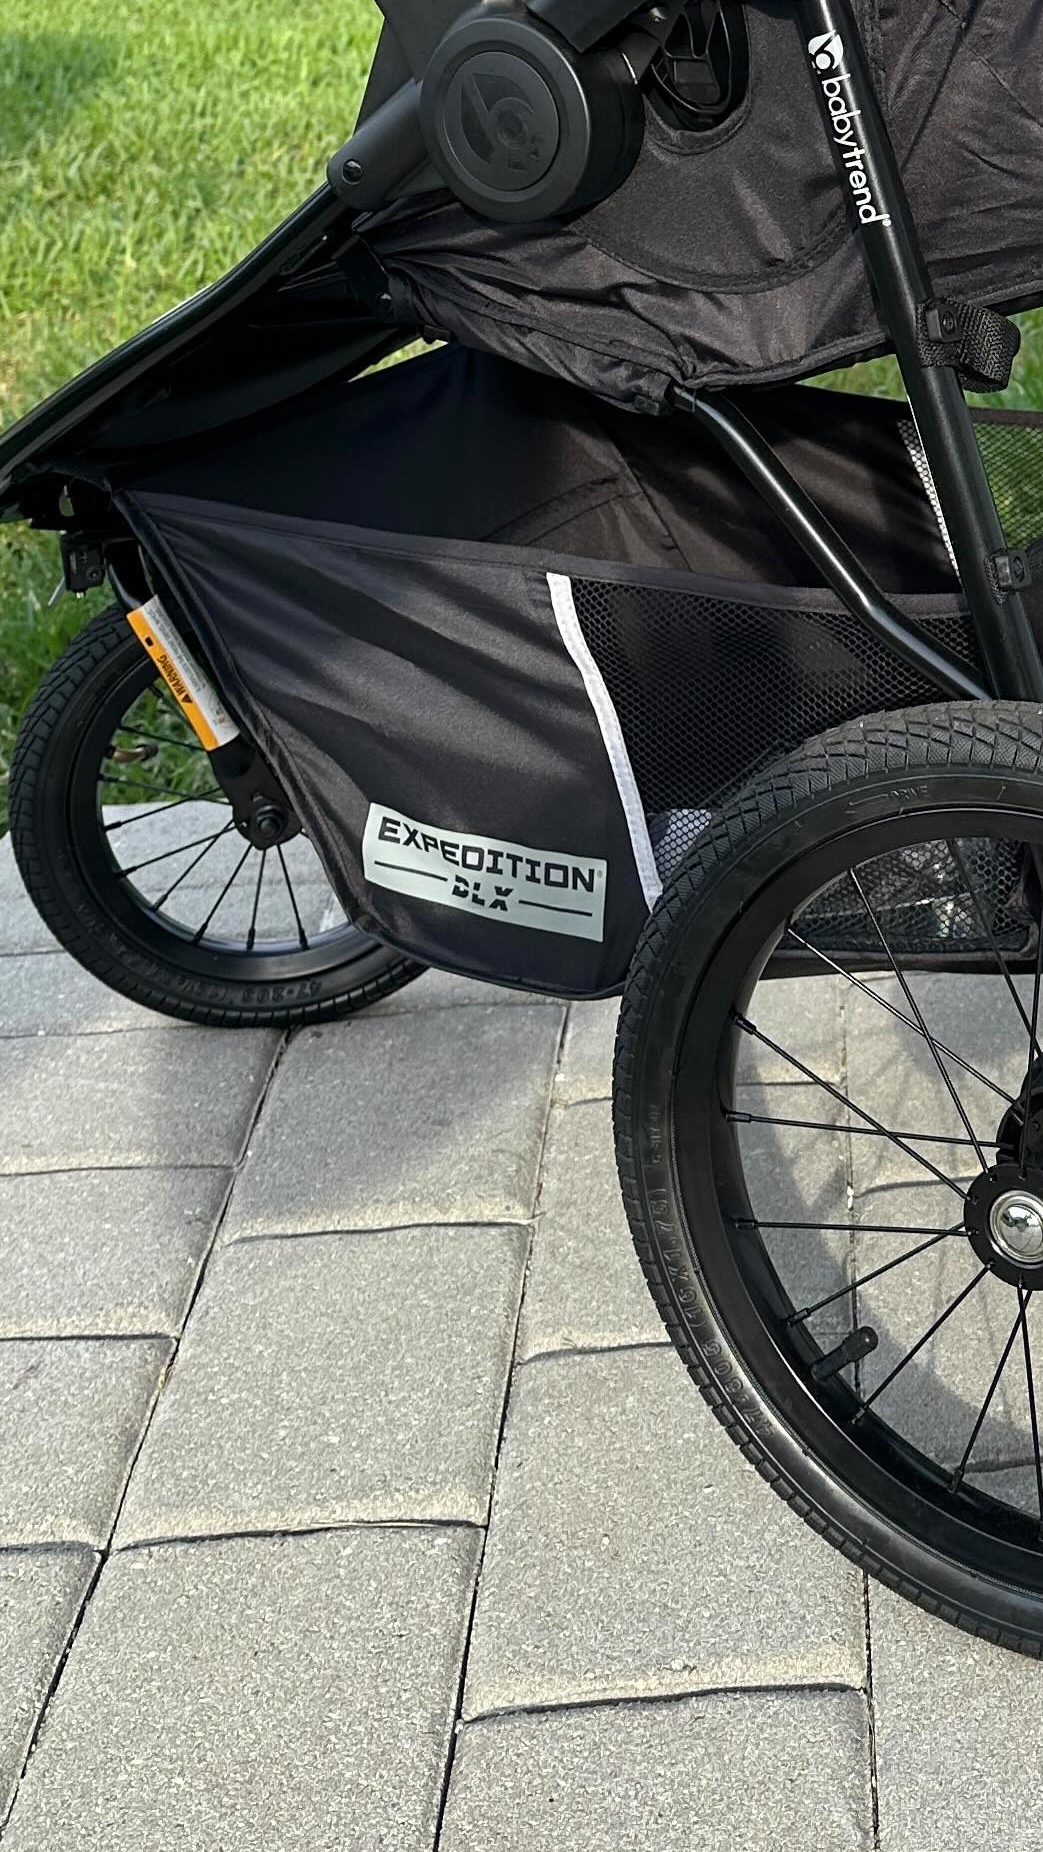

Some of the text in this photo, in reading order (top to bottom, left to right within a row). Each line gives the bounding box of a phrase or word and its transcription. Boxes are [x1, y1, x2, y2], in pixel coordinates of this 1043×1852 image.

[156, 654, 187, 695] WARNING
[378, 816, 595, 893] EXPEDITION
[451, 874, 513, 912] DLX
